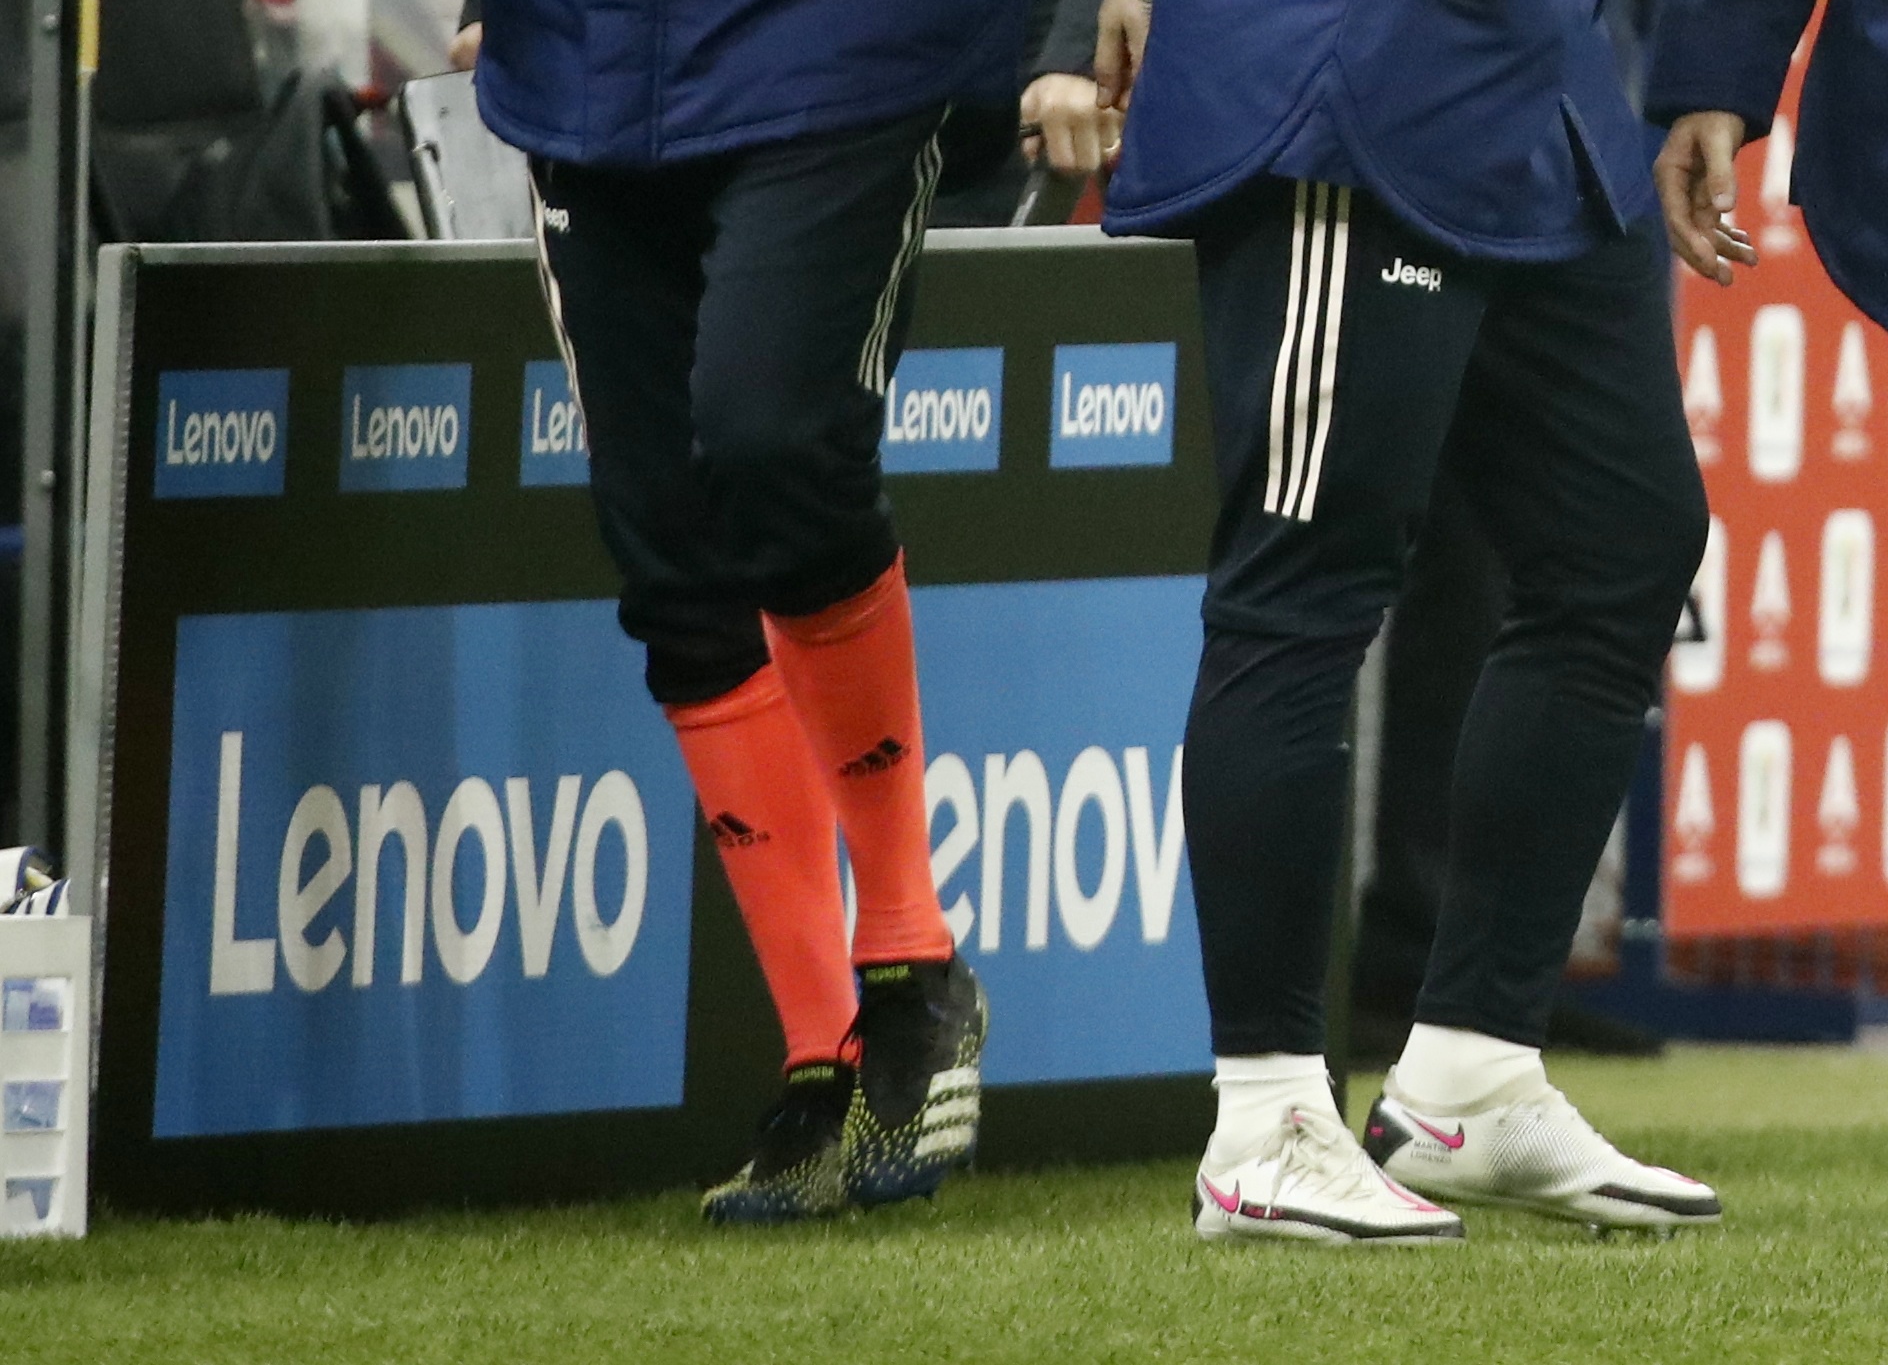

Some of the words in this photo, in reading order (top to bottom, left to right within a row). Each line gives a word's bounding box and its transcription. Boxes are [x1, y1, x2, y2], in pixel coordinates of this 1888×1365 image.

[1381, 257, 1442, 292] Jeep
[166, 399, 277, 465] Lenovo
[350, 394, 458, 460] Lenovo
[886, 377, 992, 443] Lenovo
[1061, 371, 1164, 437] Lenovo
[208, 730, 649, 997] Lenovo
